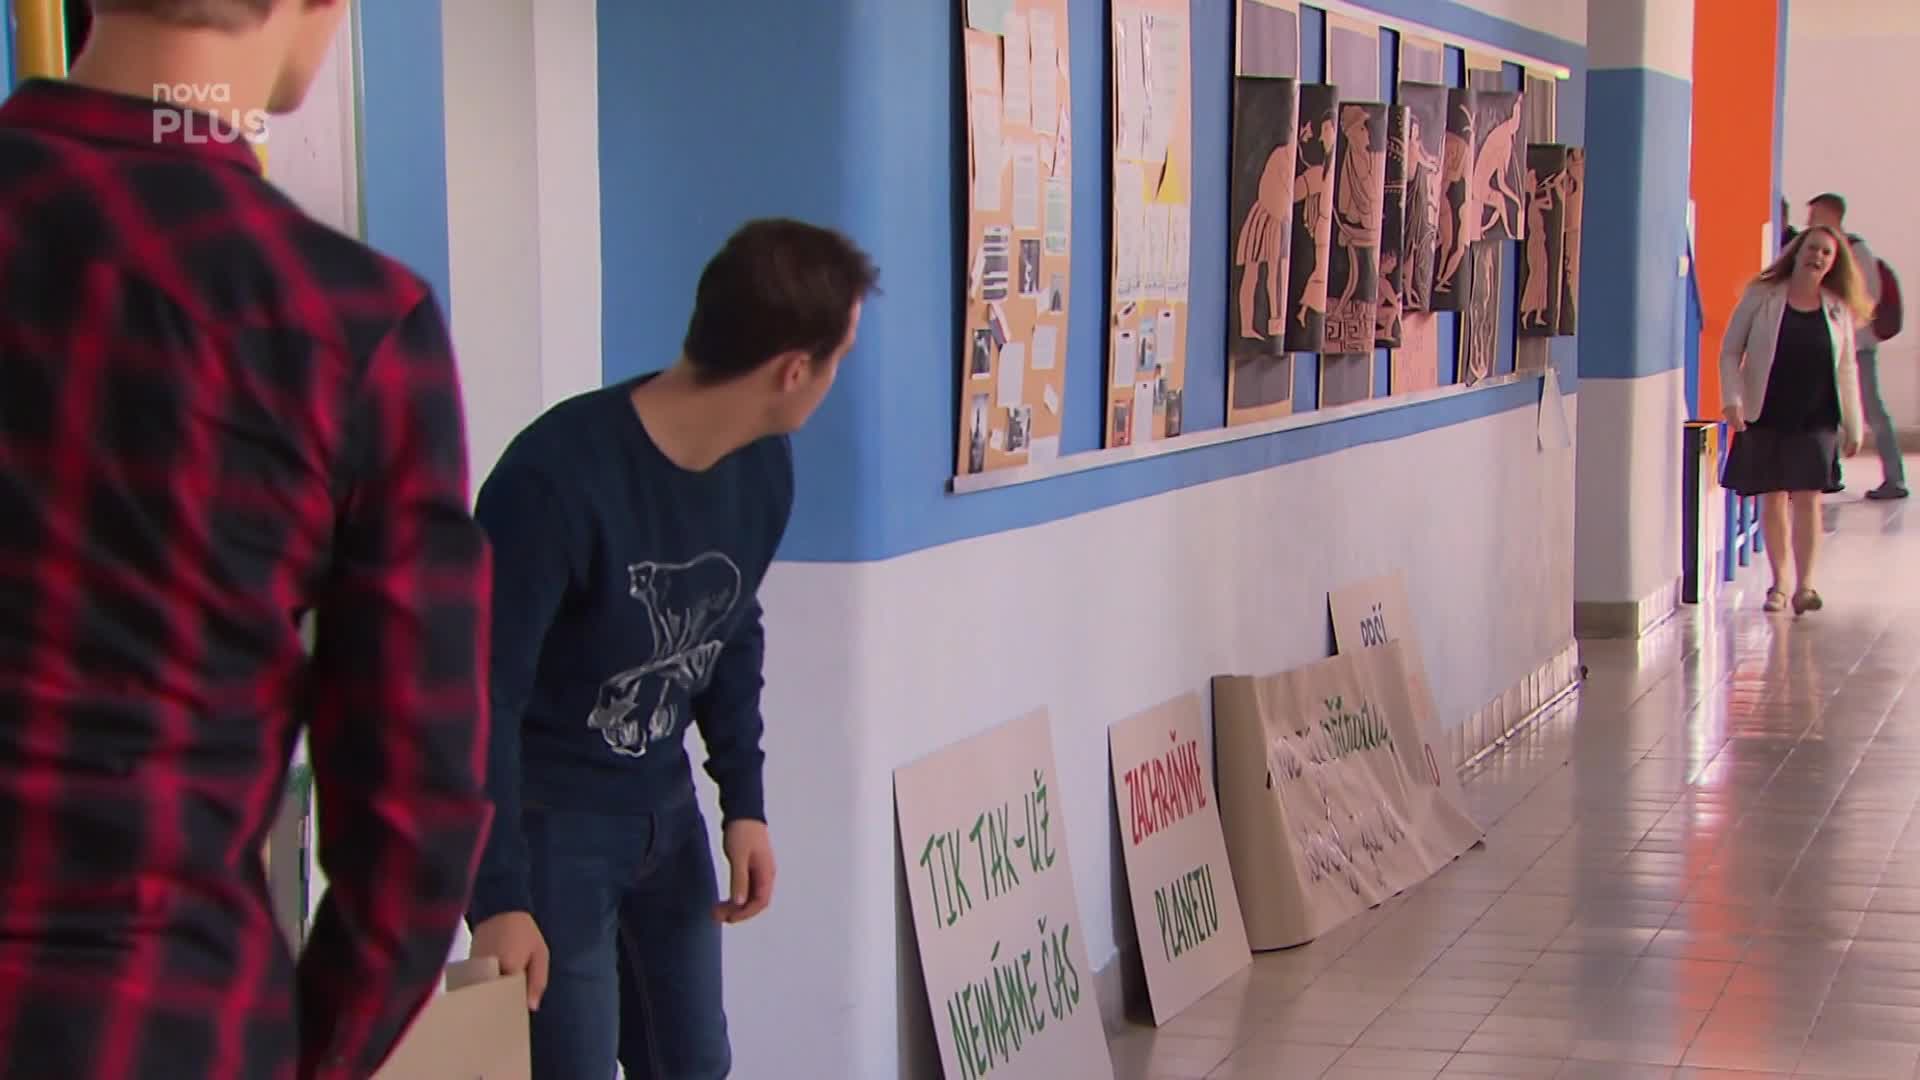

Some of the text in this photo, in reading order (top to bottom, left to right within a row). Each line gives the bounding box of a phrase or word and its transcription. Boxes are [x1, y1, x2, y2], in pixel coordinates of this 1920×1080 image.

[1124, 730, 1206, 845] ZACHRAŇME
[919, 827, 972, 928] TIK
[1154, 864, 1218, 963] PLANETU
[947, 914, 1080, 1080] NEMÁME ČAS
